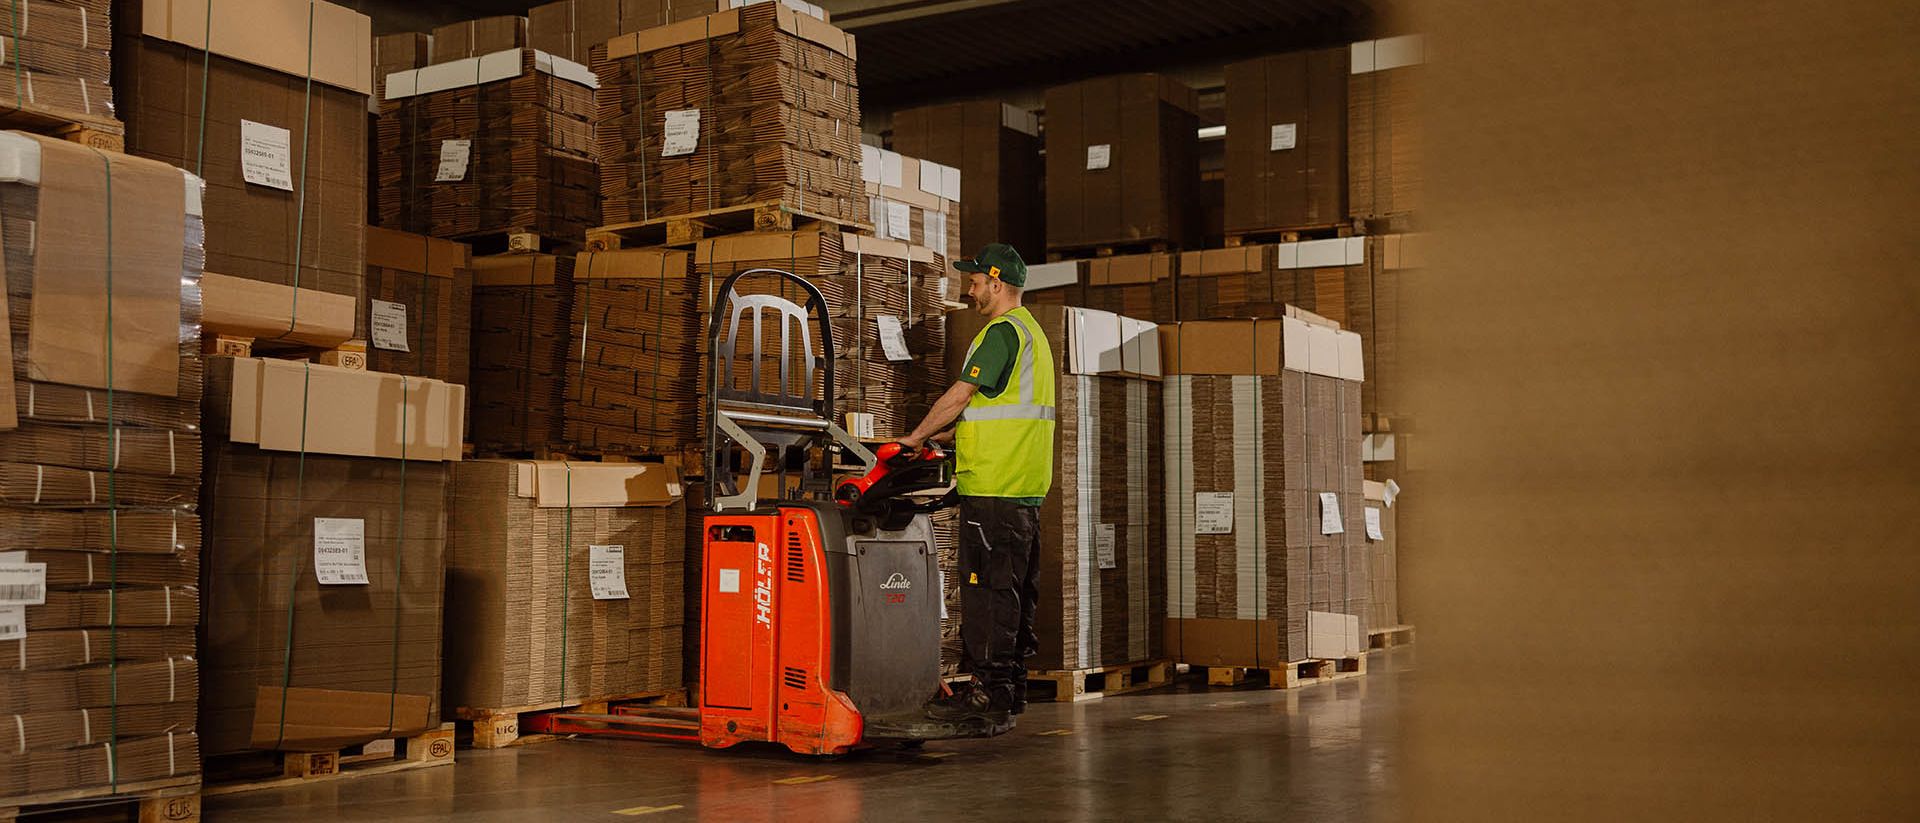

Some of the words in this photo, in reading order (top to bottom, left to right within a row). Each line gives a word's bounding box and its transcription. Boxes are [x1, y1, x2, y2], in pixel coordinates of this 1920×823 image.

[345, 355, 360, 366] EPAL
[880, 572, 911, 589] Linde
[433, 743, 448, 754] EPAL
[169, 801, 192, 817] EUR
